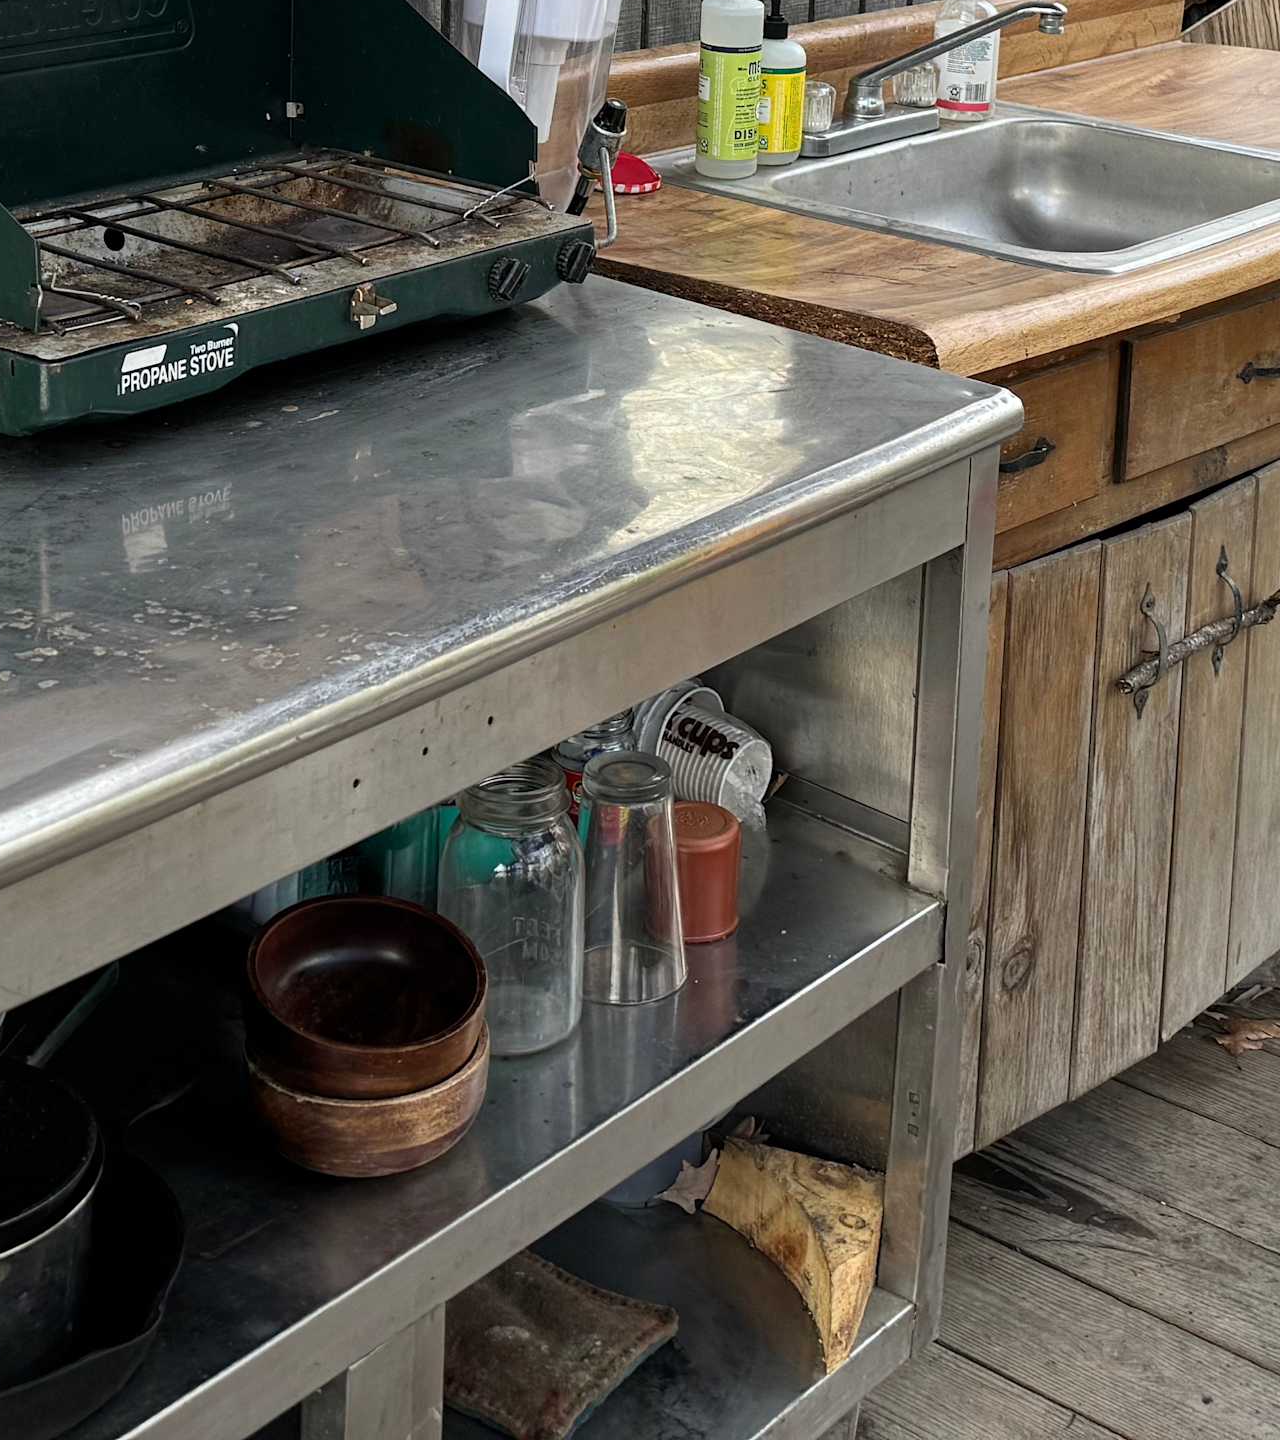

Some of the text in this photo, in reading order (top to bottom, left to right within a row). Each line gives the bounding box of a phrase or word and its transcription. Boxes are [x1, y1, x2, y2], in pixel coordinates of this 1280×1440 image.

[734, 129, 757, 140] DIS
[190, 337, 234, 356] Two Burner
[121, 347, 235, 395] PROPANE STOVE
[678, 717, 740, 759] cups
